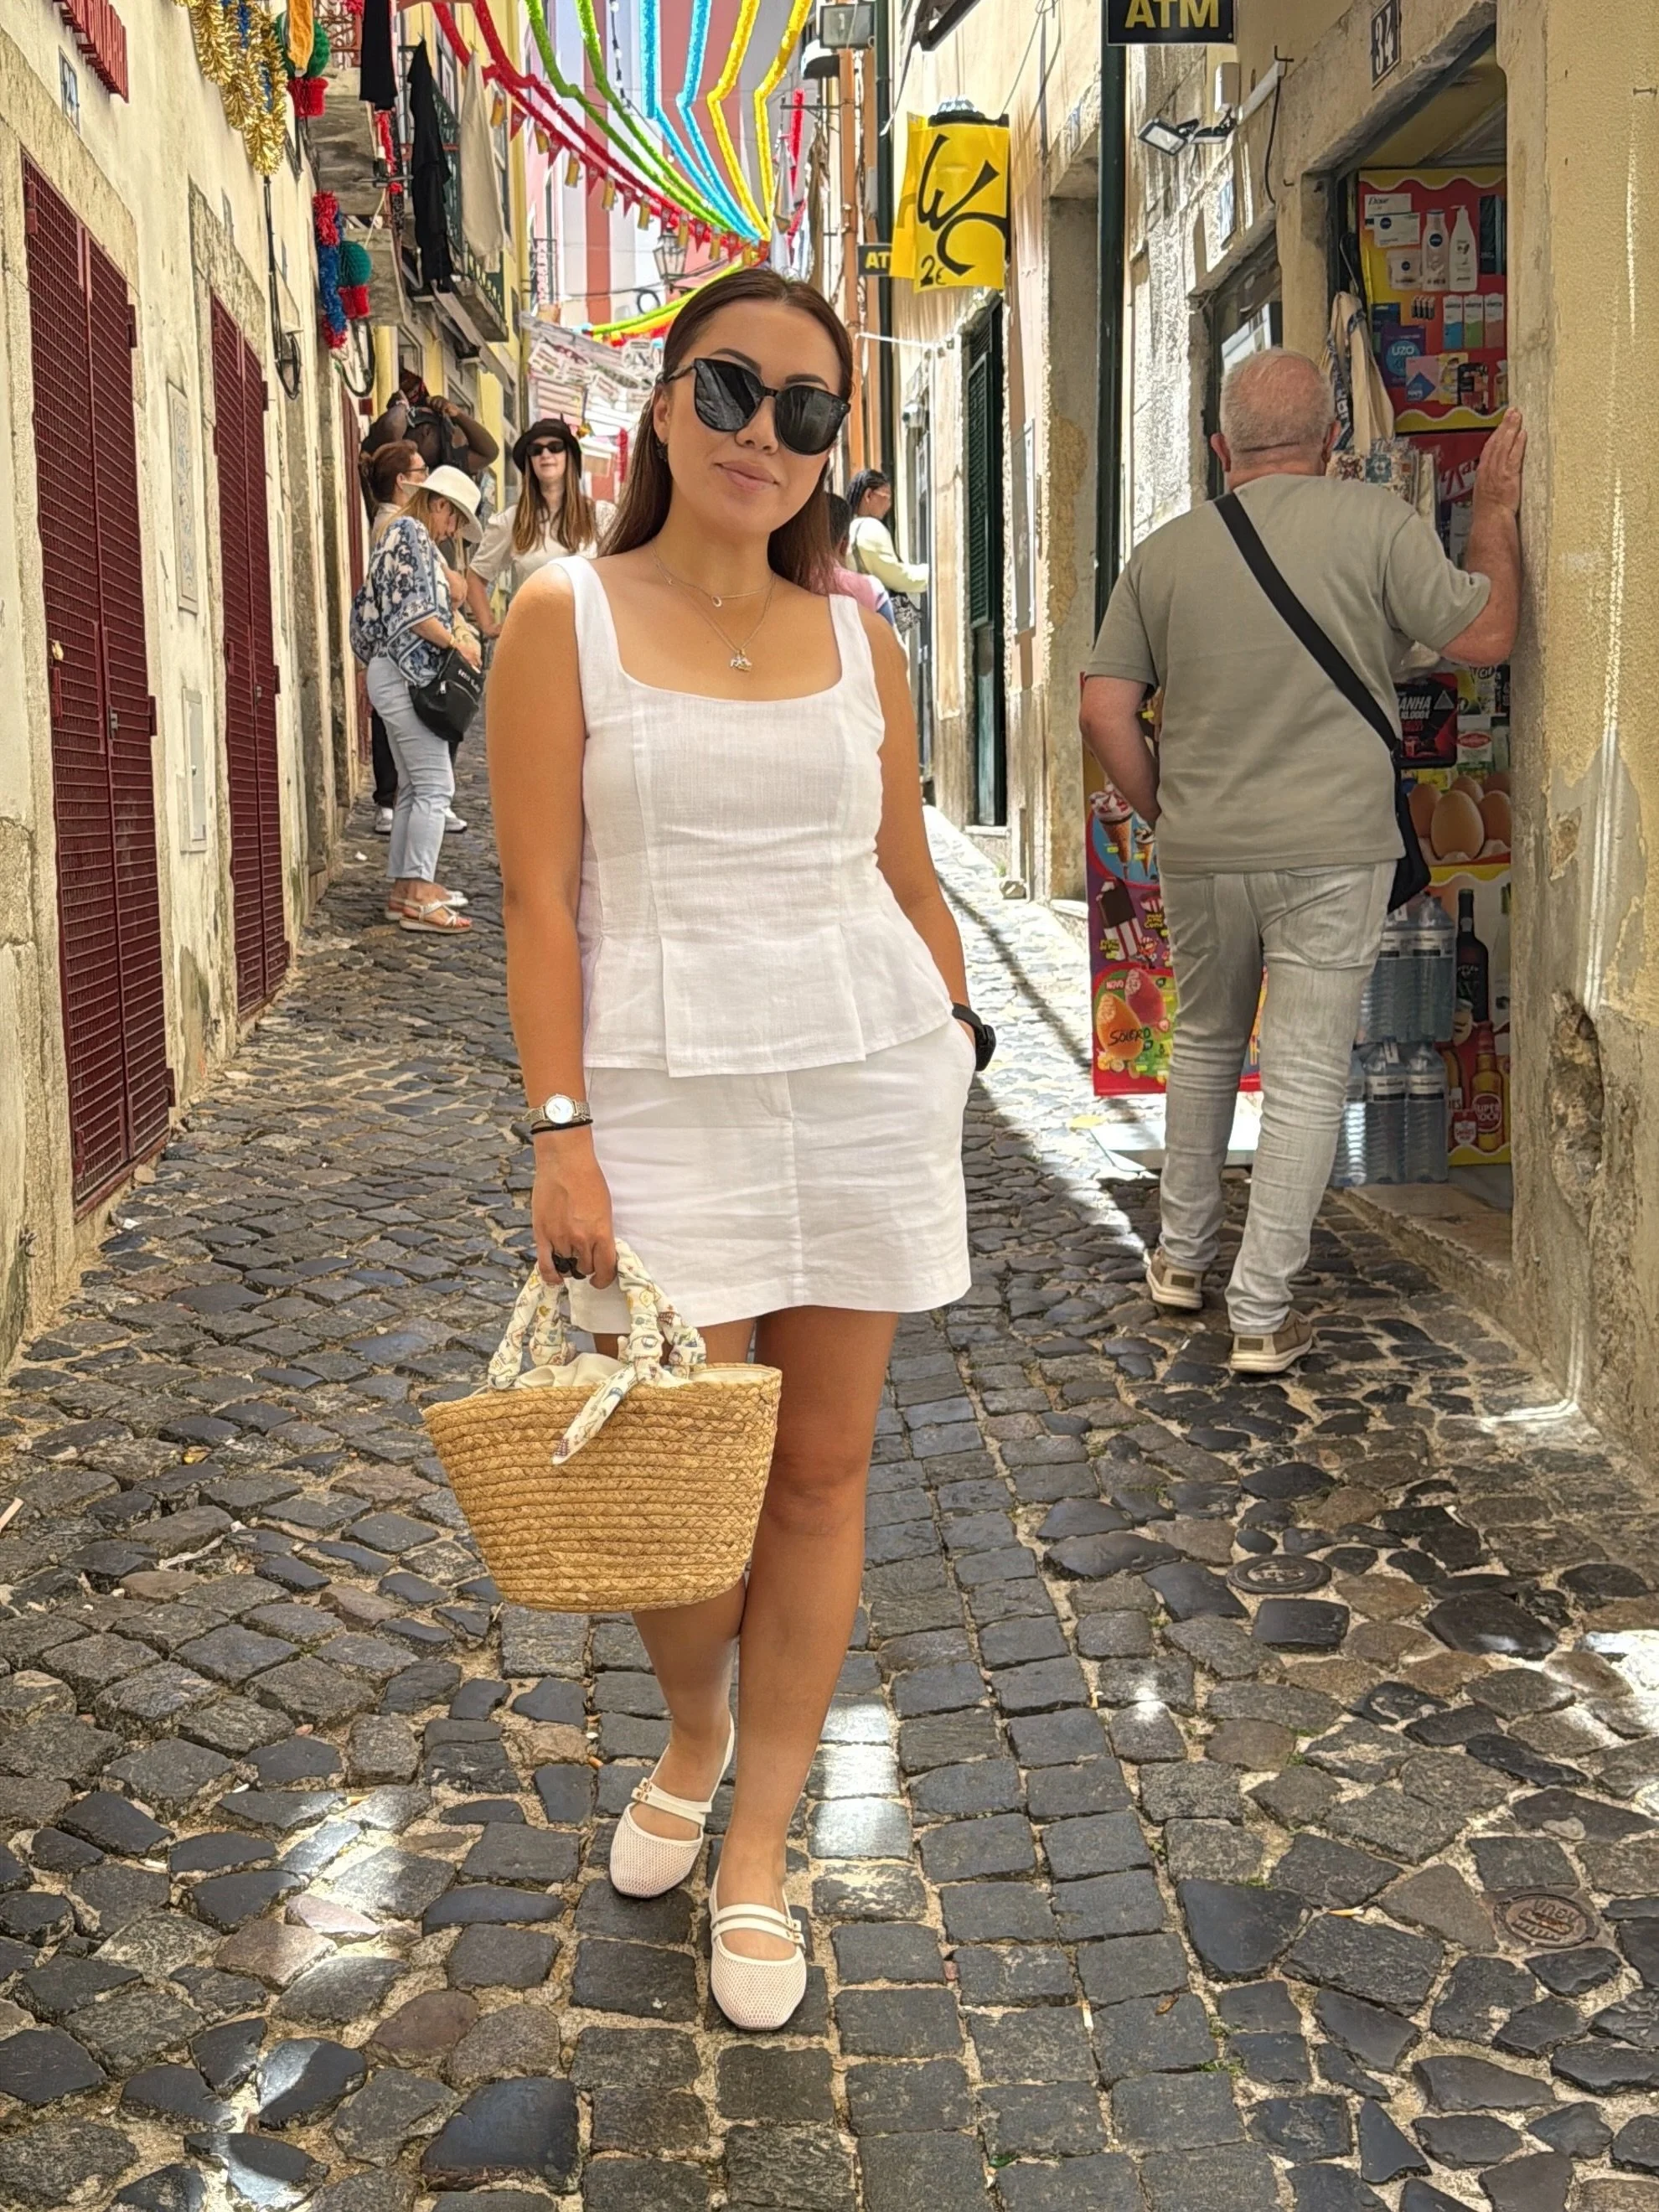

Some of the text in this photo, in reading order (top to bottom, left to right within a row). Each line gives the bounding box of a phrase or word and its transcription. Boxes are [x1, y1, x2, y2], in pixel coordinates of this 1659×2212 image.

[1124, 0, 1219, 28] ATM
[917, 133, 1007, 275] WC
[865, 251, 891, 269] AT
[1398, 695, 1432, 711] ANHA
